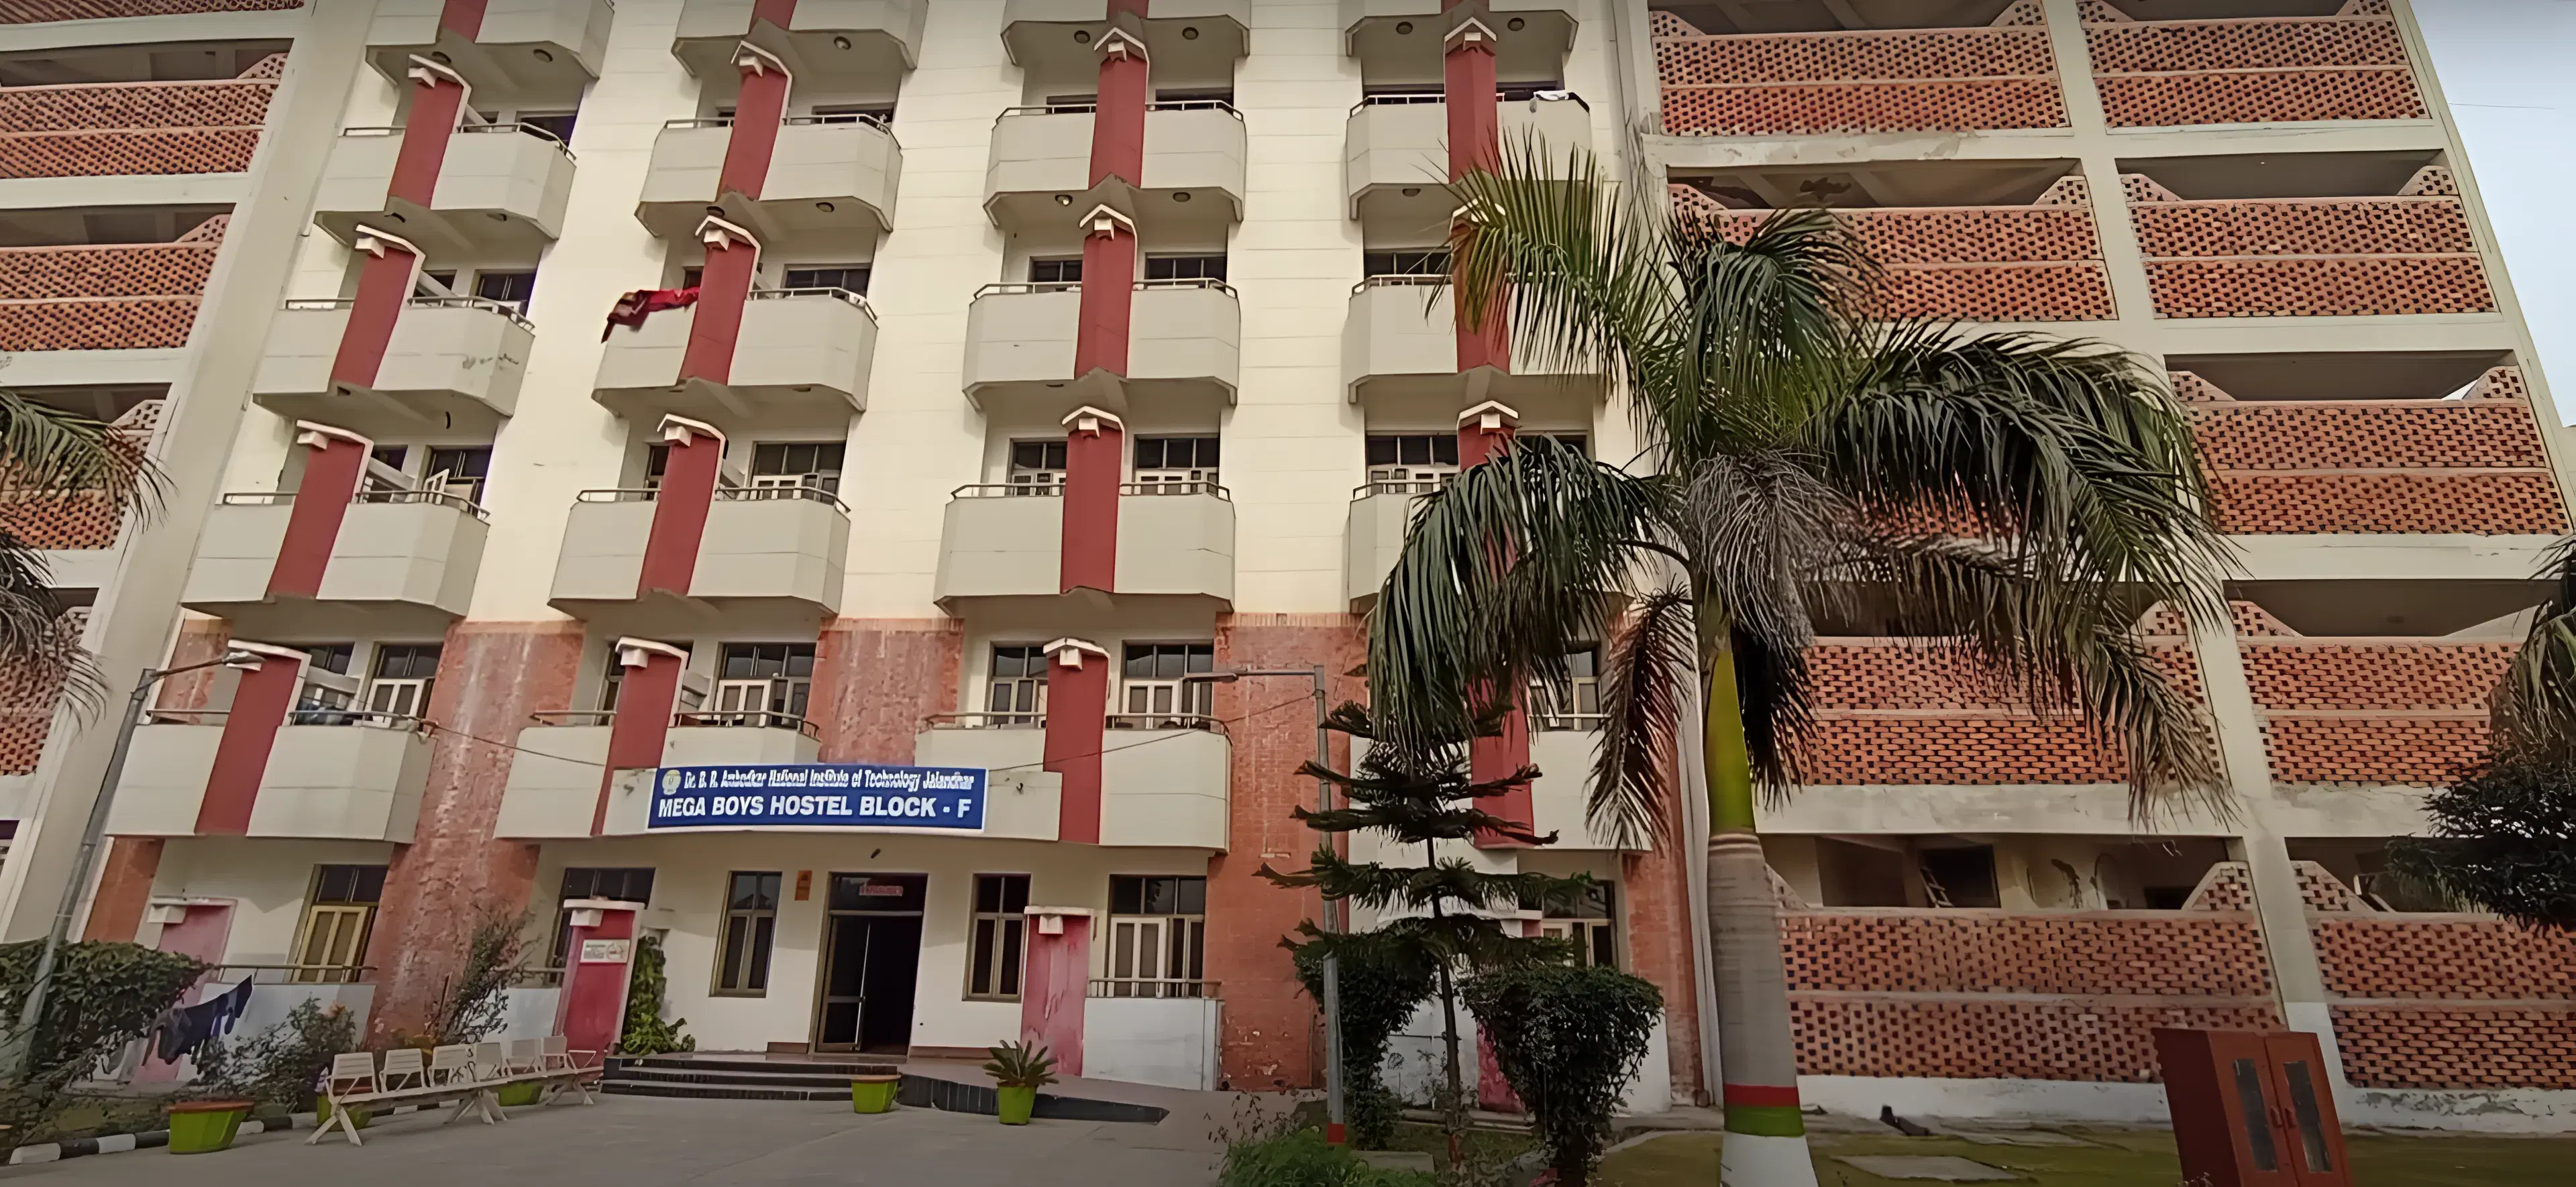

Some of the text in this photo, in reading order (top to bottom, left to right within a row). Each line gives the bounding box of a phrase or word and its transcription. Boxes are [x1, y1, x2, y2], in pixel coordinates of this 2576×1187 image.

[851, 769, 863, 788] of
[864, 769, 921, 793] Technology
[658, 796, 706, 817] MEGA
[711, 795, 764, 815] BOYS
[769, 795, 853, 815] HOSTEL
[859, 796, 936, 817] BLOCK
[957, 798, 972, 818] F
